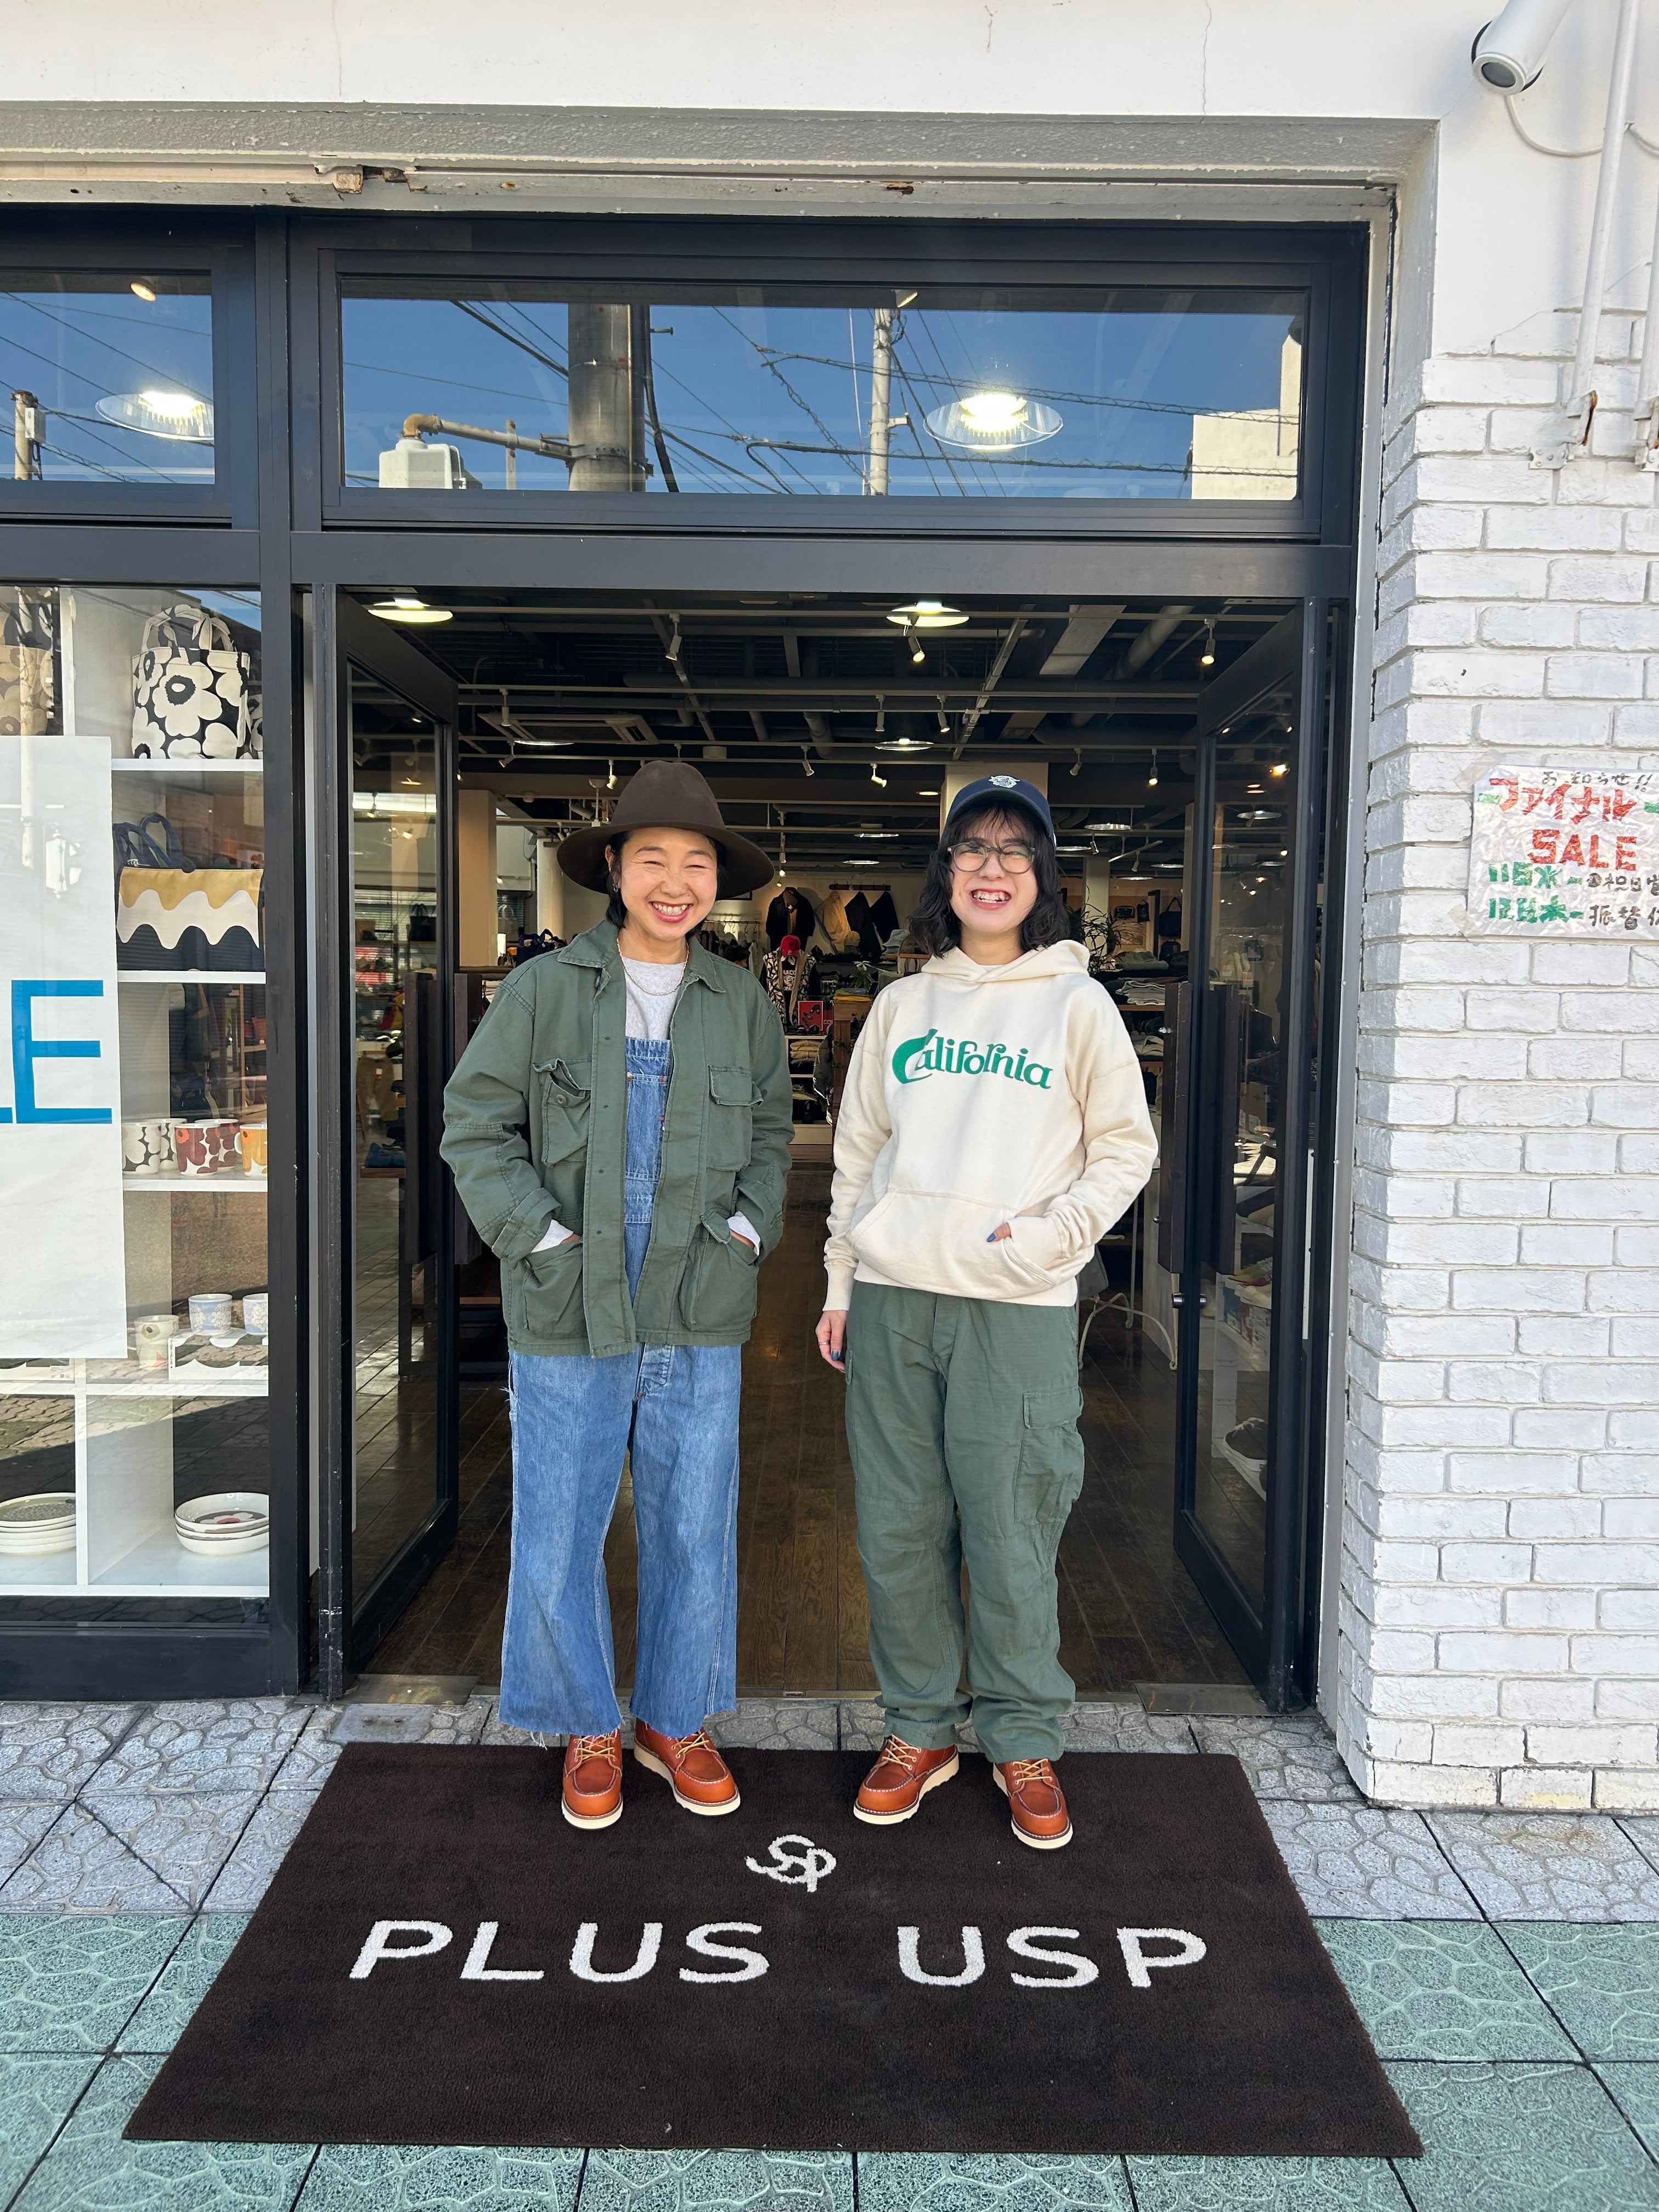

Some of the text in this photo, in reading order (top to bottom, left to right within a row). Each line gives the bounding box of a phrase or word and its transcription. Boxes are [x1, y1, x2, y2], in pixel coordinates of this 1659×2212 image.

[1488, 777, 1638, 825] ファイナル
[1527, 829, 1638, 871] SALE
[0, 980, 112, 1124] E
[892, 1029, 1053, 1089] California
[349, 1920, 1207, 1988] PLUS USP
